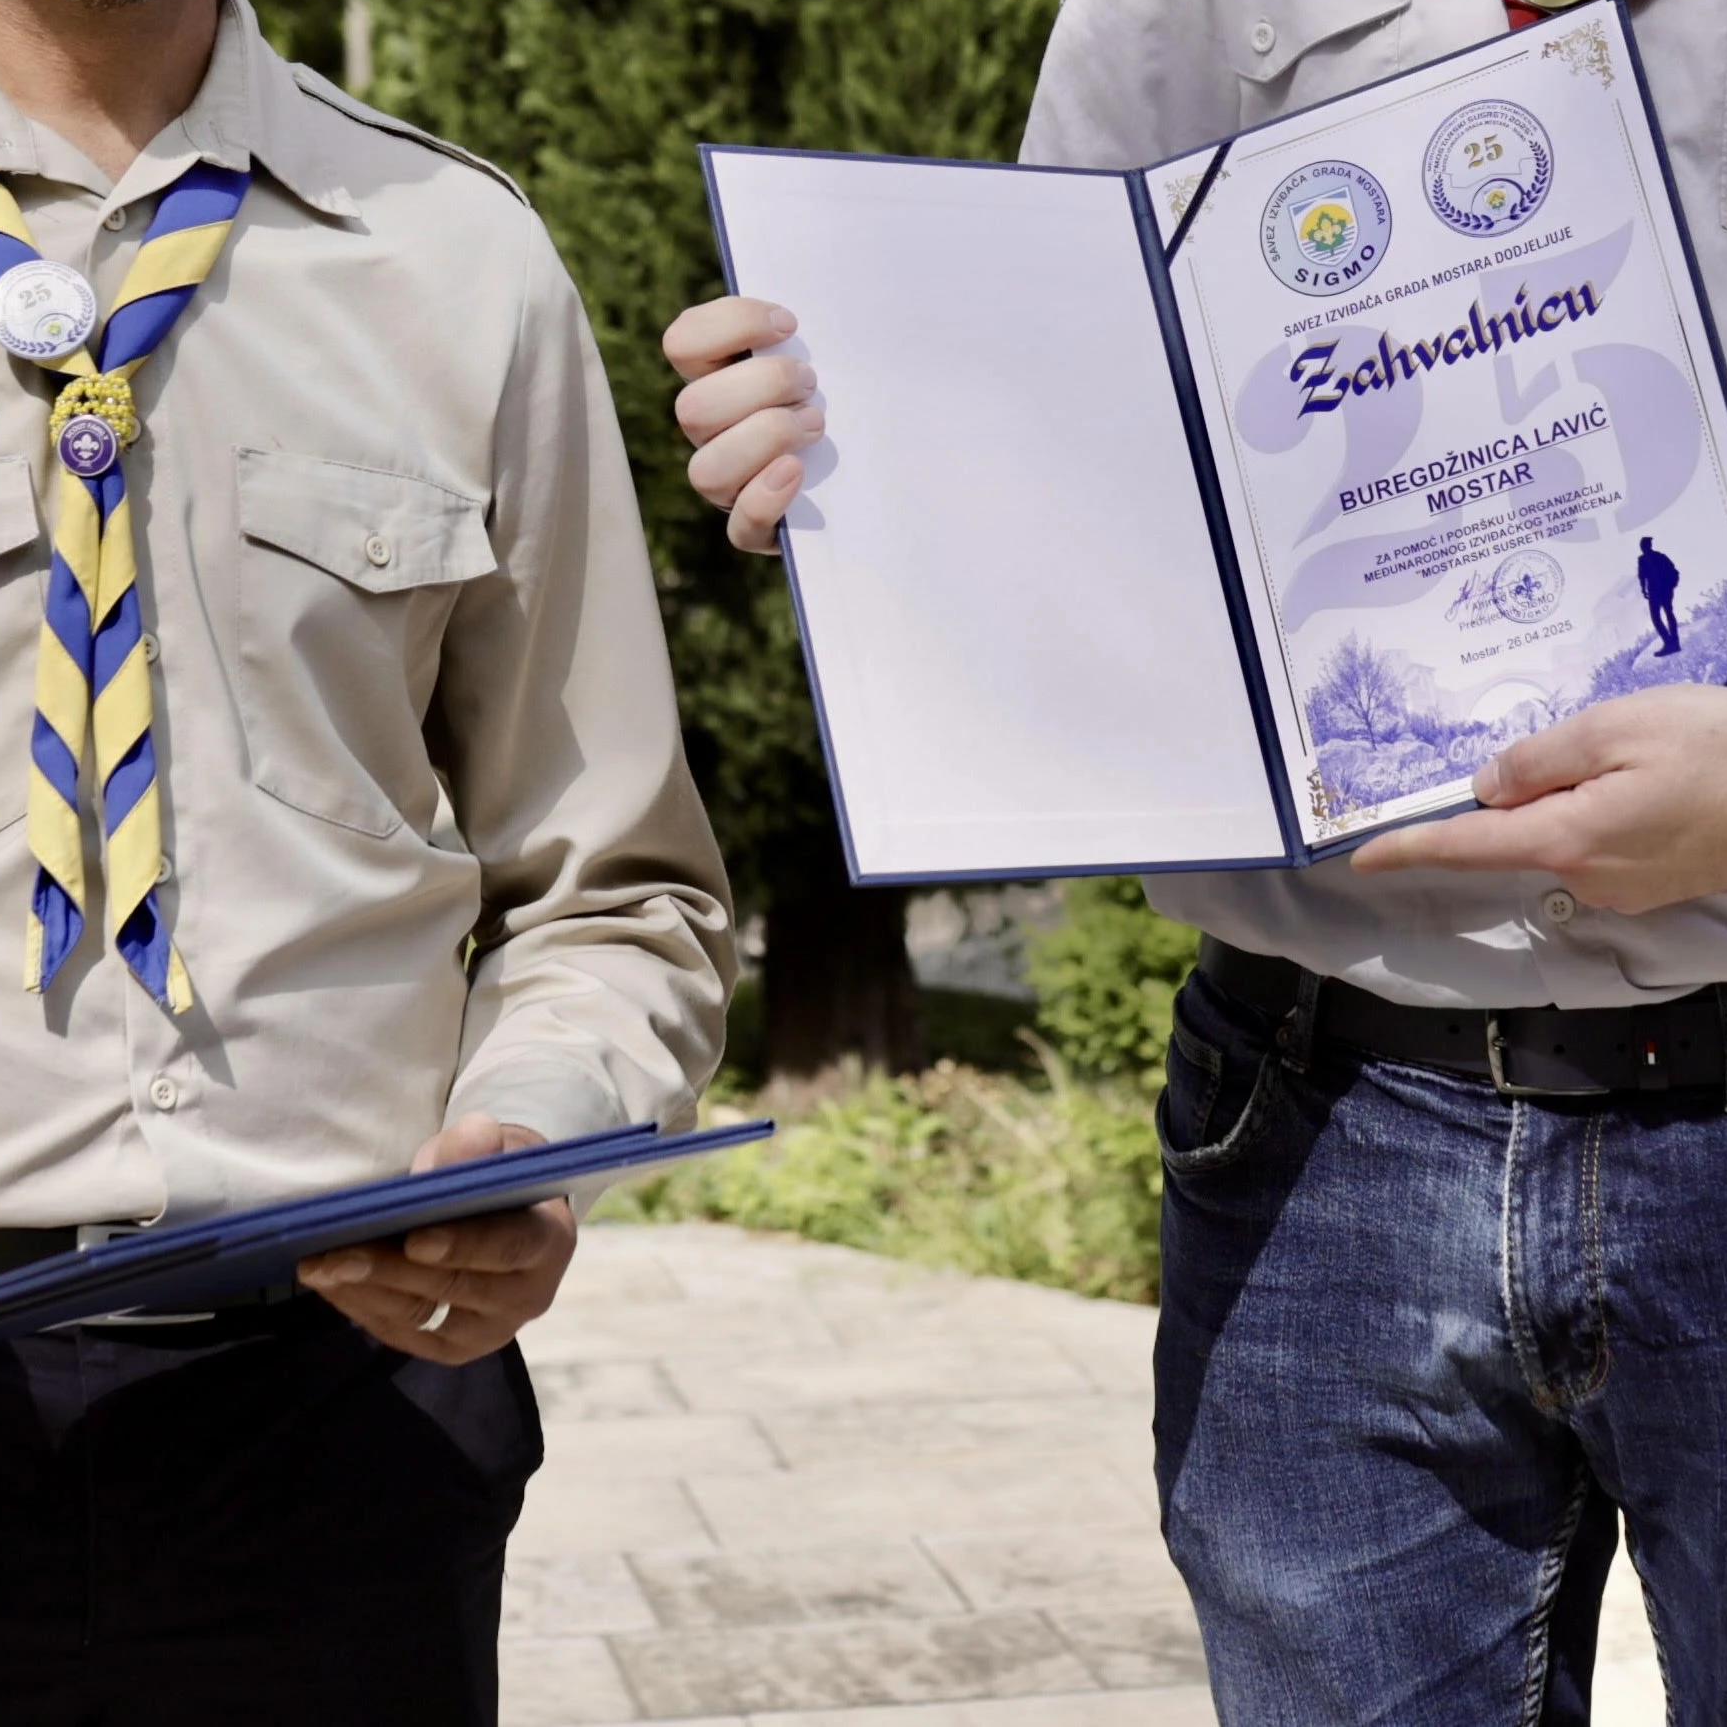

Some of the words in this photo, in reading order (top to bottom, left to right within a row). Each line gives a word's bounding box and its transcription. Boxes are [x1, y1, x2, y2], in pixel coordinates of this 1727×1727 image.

[1463, 133, 1504, 170] 25
[1266, 225, 1281, 263] SAVEZ
[1312, 166, 1353, 179] GRADA
[1355, 175, 1386, 226] MOSTARA
[18, 280, 53, 310] 25
[1283, 314, 1324, 338] SAVEZ
[1325, 292, 1384, 324] IZVIĐAČA
[1385, 277, 1430, 304] GRADA
[1431, 256, 1493, 291] MOSTARA
[1494, 226, 1574, 264] DODJELJUJE
[1294, 244, 1376, 287] SIGMO
[1289, 277, 1606, 421] Zahvalnicu
[1339, 433, 1530, 513] BUREGDŽINICA
[1533, 402, 1608, 448] LAVIĆ
[1426, 461, 1535, 513] MOSTAR
[1363, 541, 1467, 584] MEĐUNARODNOG
[1468, 515, 1544, 549] IZVIĐAČKOG
[1545, 490, 1623, 524] TAKMIČENJA
[1375, 552, 1392, 567] ZA
[1393, 533, 1439, 562] POMOĆ
[1446, 514, 1506, 542] PODRŠKU
[1506, 509, 1518, 522] U
[1518, 481, 1605, 519] ORGANIZACIJI
[1415, 547, 1492, 579] "MOSTARSKI
[1492, 531, 1545, 555] SUSRETI
[1545, 517, 1579, 539] 2025"
